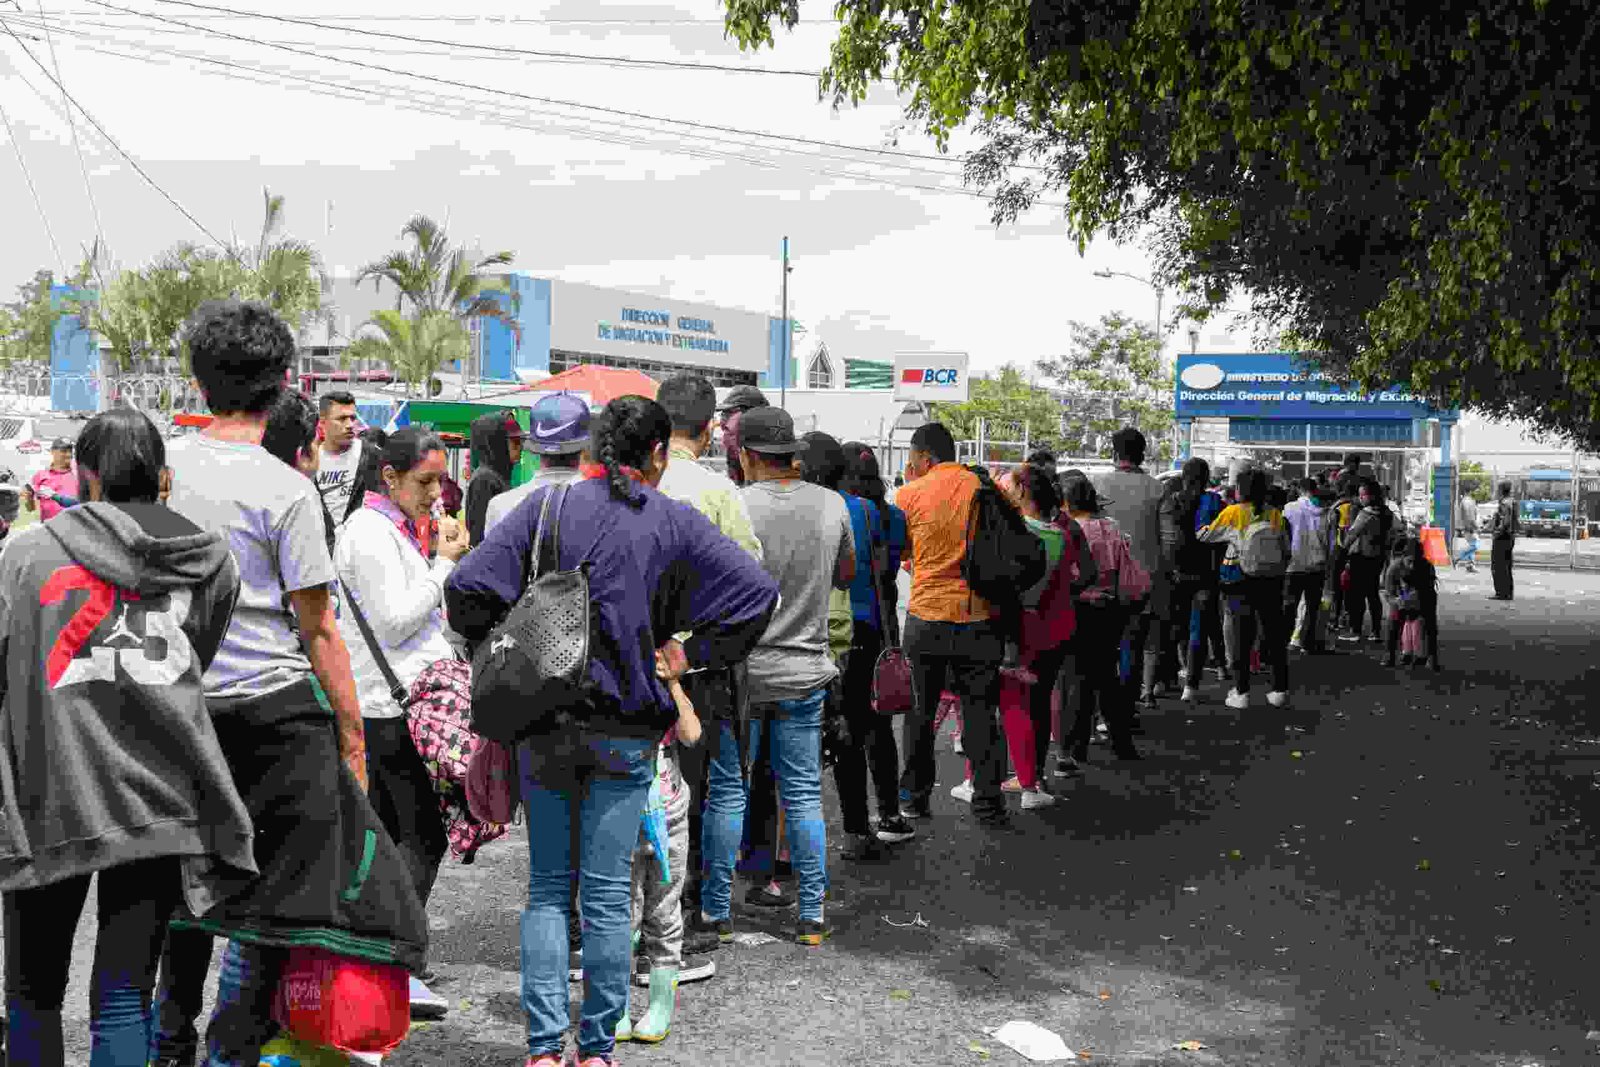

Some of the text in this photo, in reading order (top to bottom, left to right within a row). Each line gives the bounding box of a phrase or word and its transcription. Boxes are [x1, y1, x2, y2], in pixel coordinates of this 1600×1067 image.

[924, 368, 958, 383] BCR
[1180, 390, 1235, 401] Dirección
[1238, 390, 1283, 401] General
[1287, 390, 1302, 401] de
[319, 470, 350, 485] NIKE
[39, 564, 193, 688] 23
